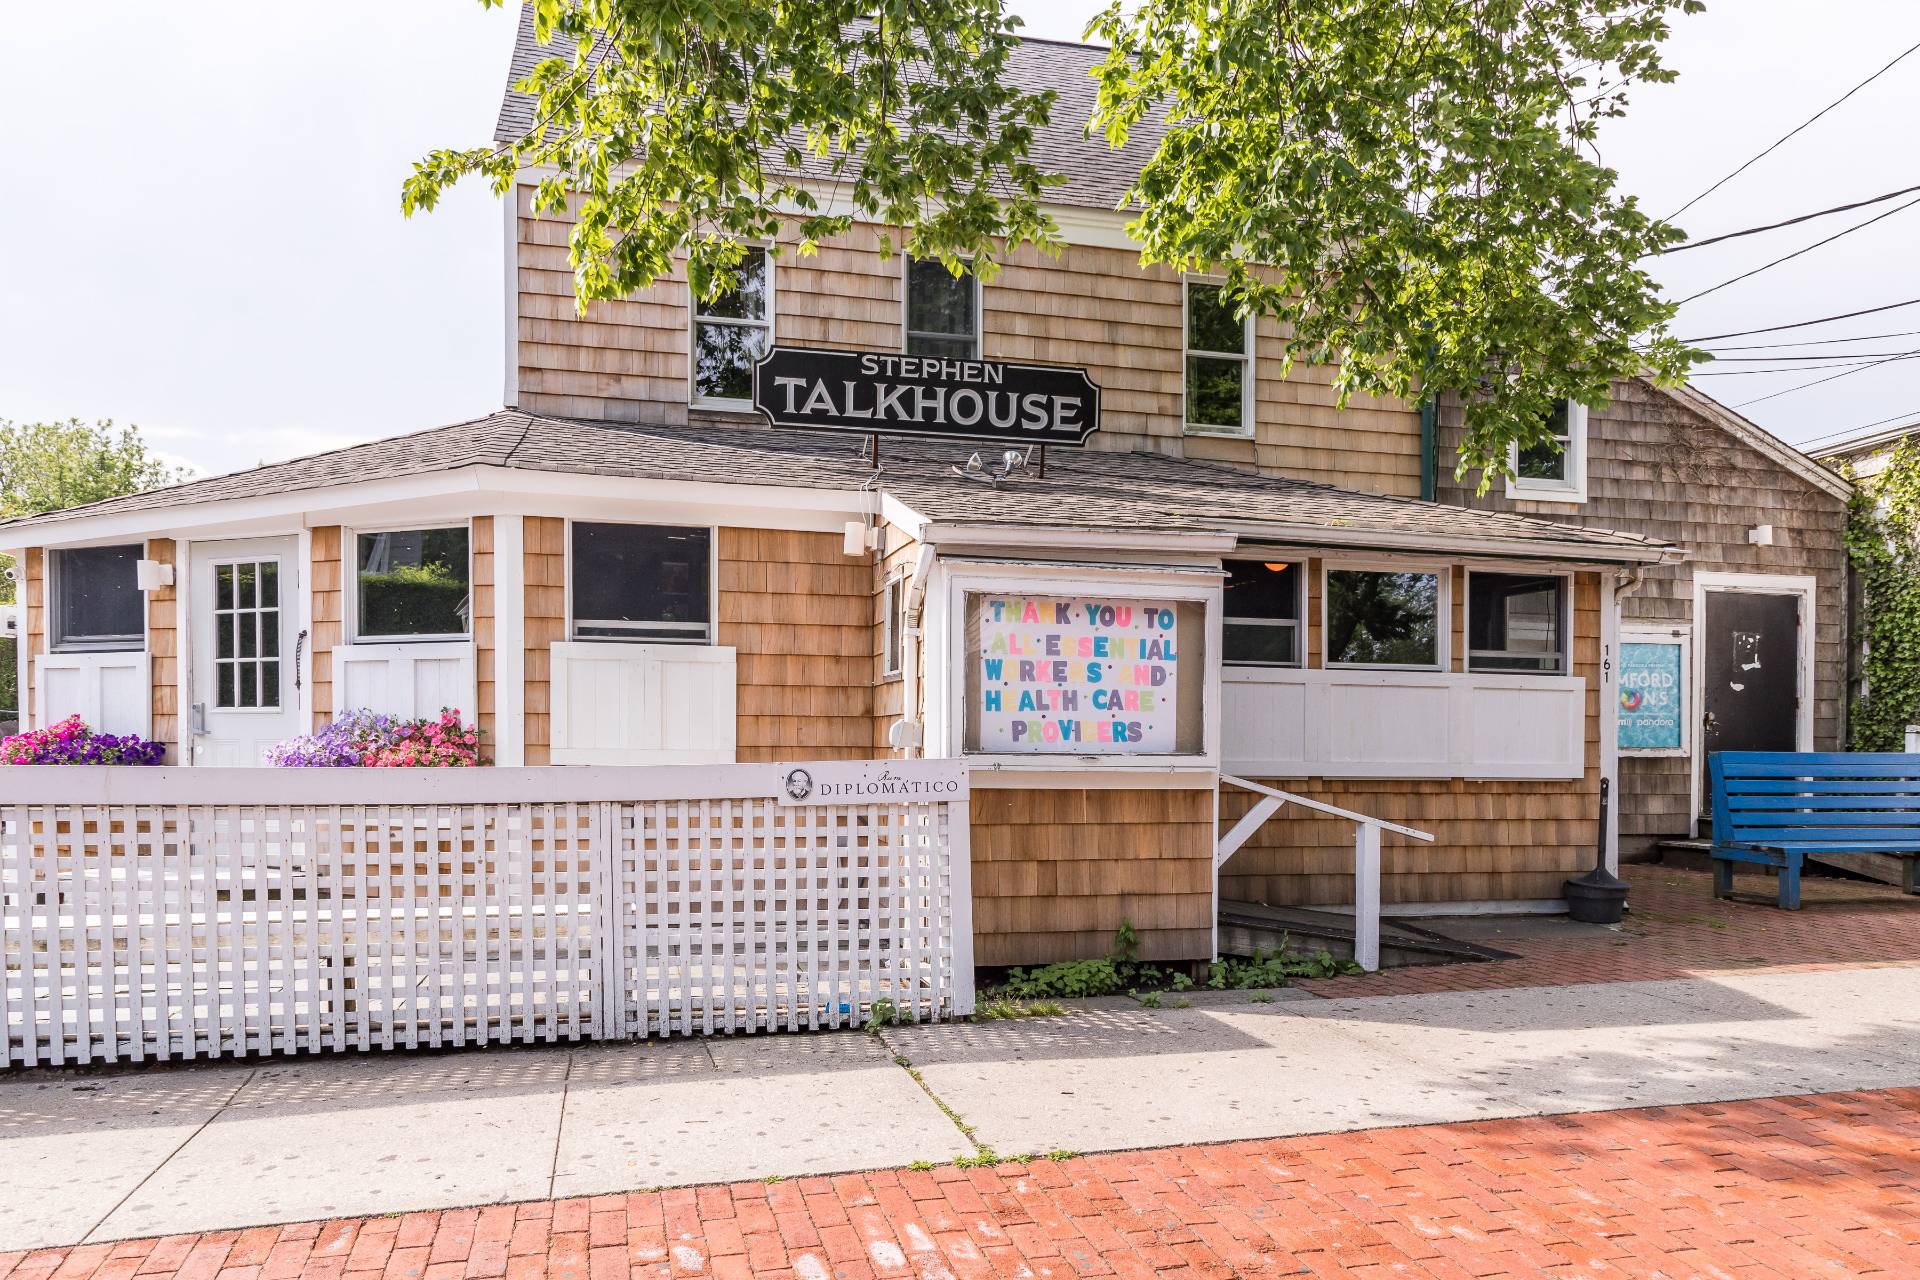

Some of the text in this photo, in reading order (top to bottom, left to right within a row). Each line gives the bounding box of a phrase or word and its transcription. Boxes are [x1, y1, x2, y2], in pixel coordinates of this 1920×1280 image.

[860, 354, 1004, 385] STEPHEN
[773, 375, 1084, 432] TALKHOUSE
[989, 599, 1175, 630] THANK YOU TO
[991, 632, 1177, 661] ALL ESSENTIAL
[984, 658, 1167, 687] WORKERS AND
[1603, 644, 1611, 684] 161
[985, 688, 1155, 712] HEALTH CARE
[1011, 719, 1143, 743] PROVIDERS
[1637, 717, 1674, 727] pandora
[820, 779, 959, 796] DIPLOMÁTICO
